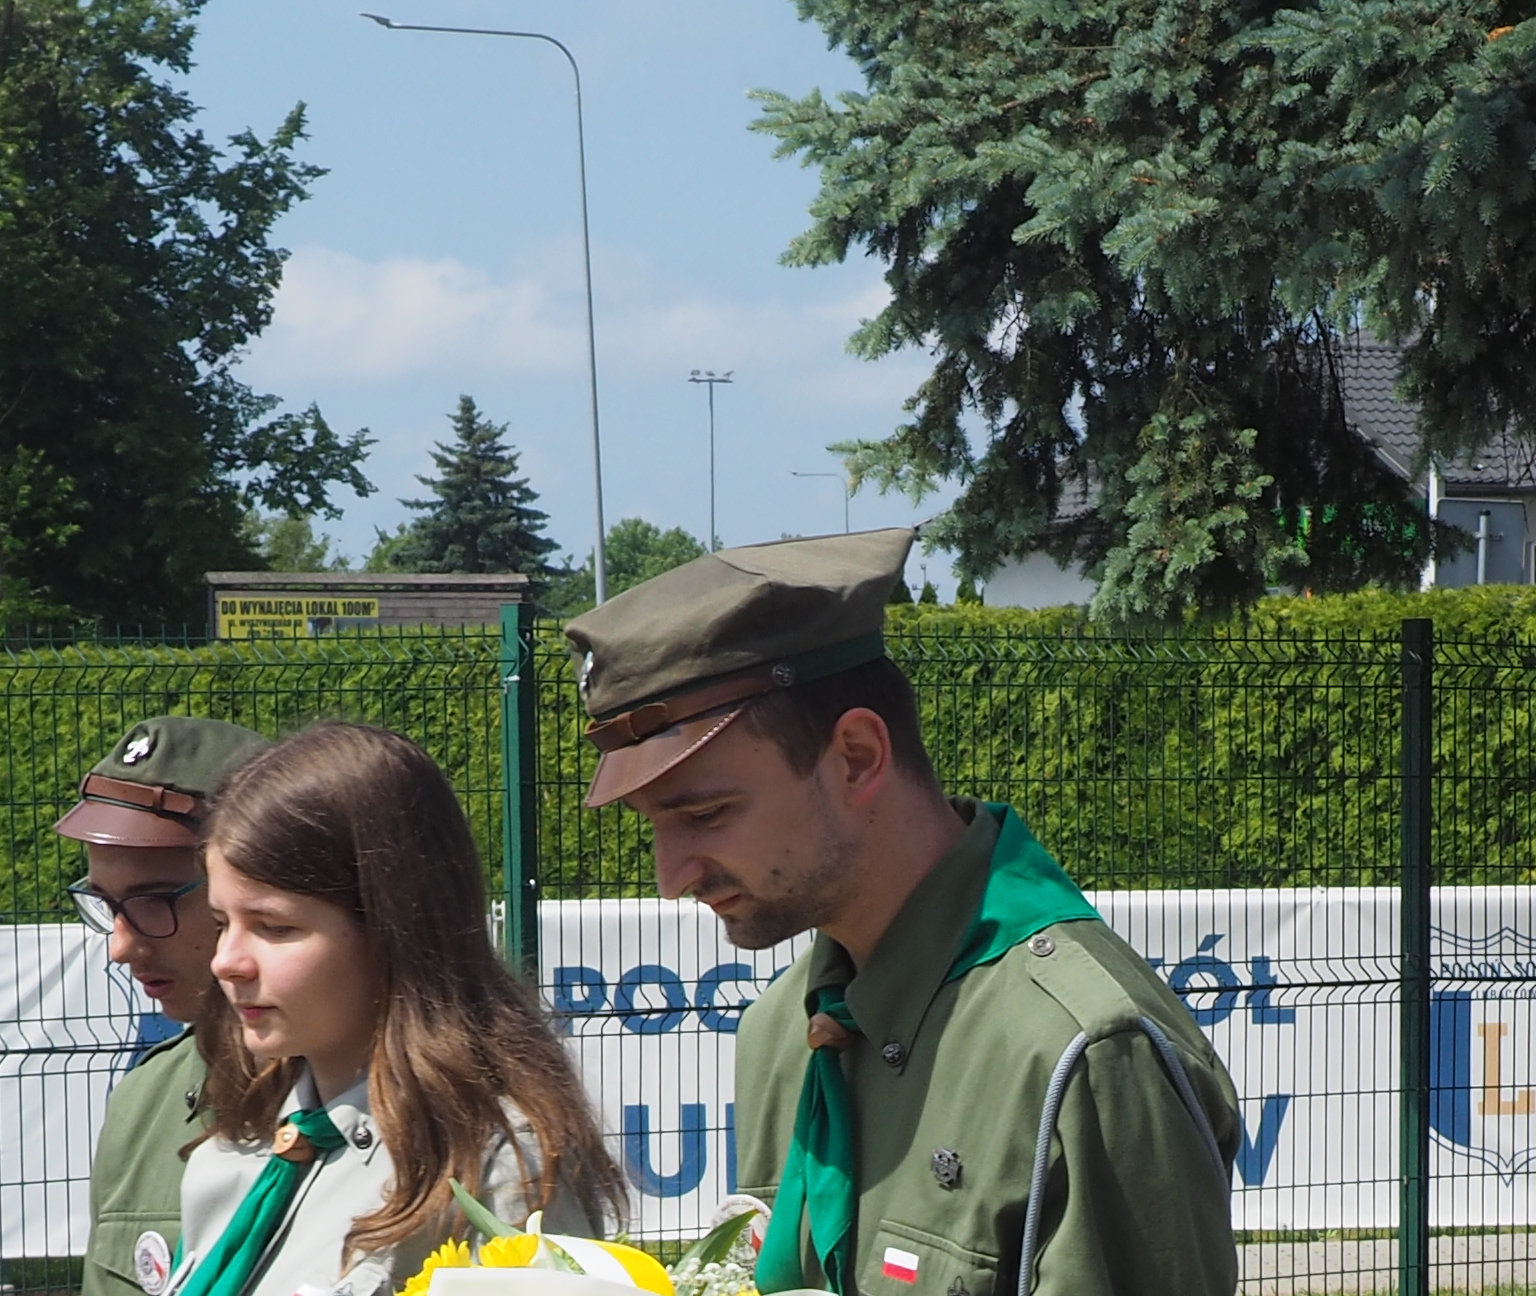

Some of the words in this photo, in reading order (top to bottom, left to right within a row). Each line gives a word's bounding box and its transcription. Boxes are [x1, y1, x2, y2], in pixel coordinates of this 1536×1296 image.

[221, 600, 237, 616] DO
[239, 600, 304, 619] WYNAJĘCIA
[306, 601, 339, 616] LOKAL
[1478, 1022, 1536, 1115] L
